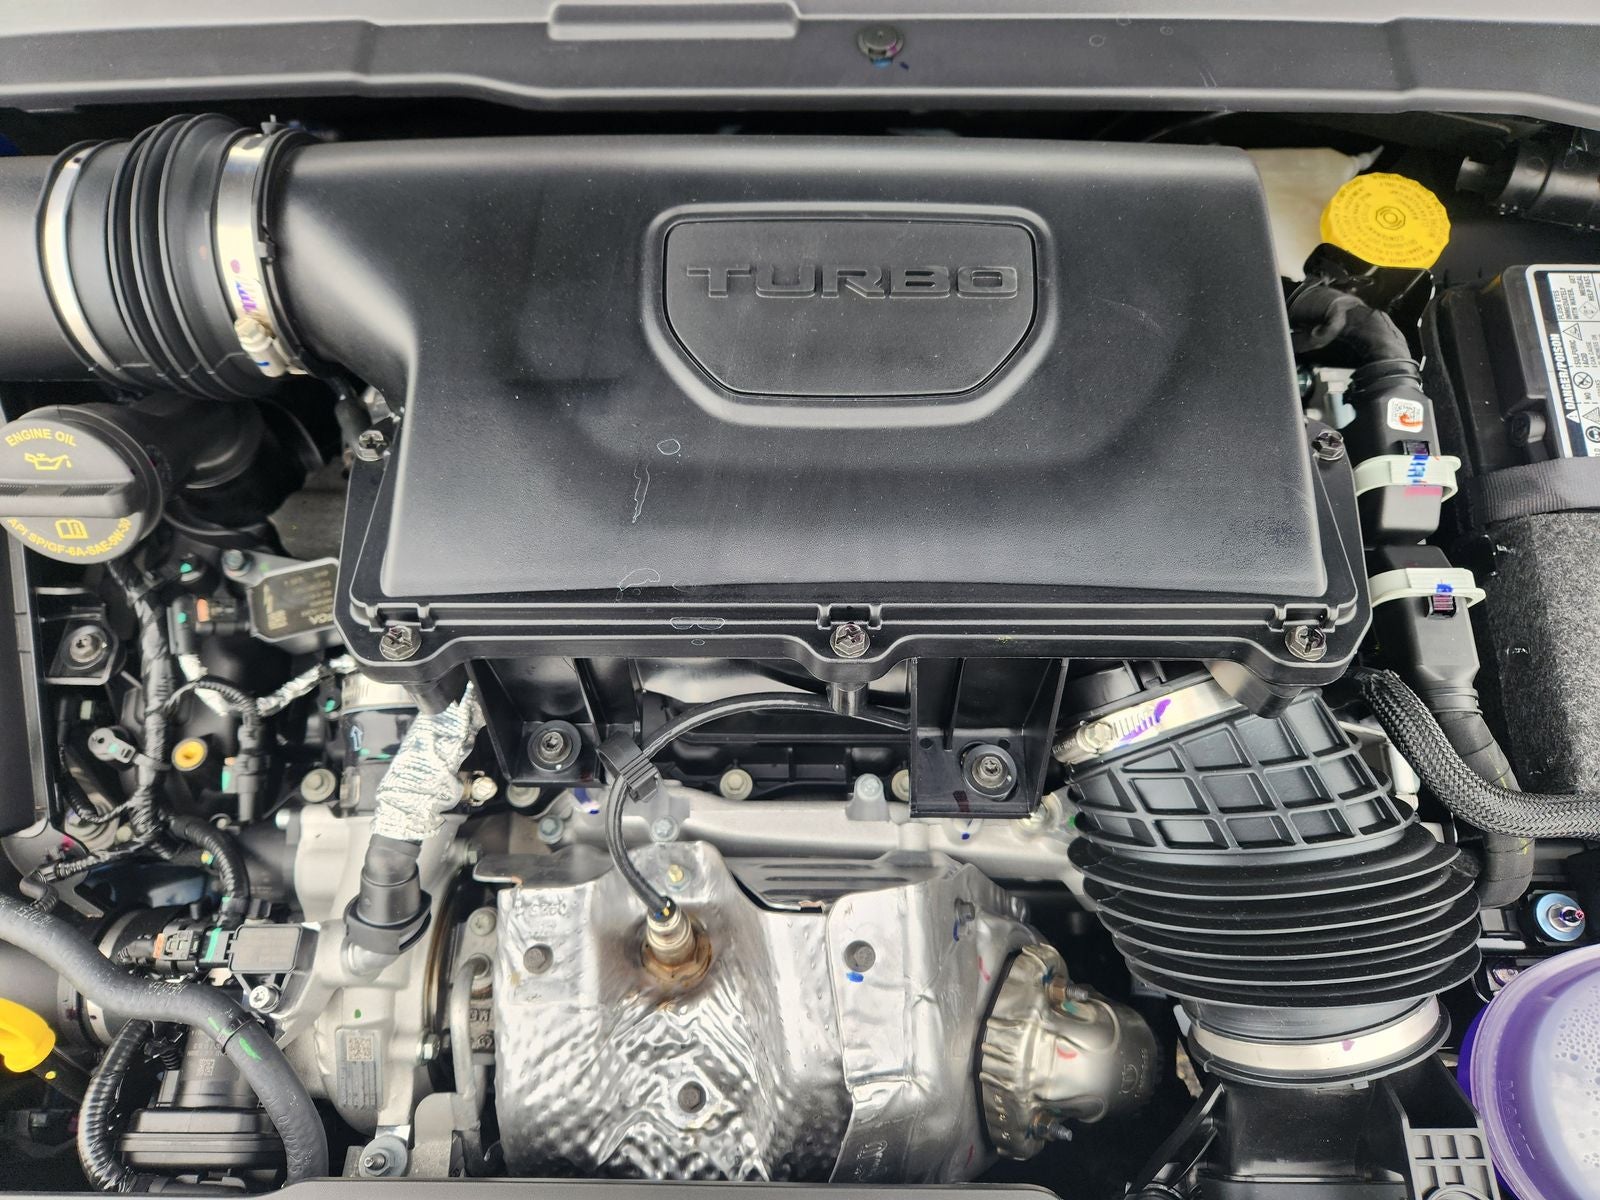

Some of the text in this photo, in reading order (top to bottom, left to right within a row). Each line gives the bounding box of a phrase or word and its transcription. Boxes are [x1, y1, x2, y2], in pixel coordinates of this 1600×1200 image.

[686, 265, 1018, 298] TURBO
[1553, 289, 1561, 302] EYES
[1550, 334, 1576, 410] DANGER/POISON
[5, 428, 77, 447] ENGINE OIL
[7, 518, 29, 536] API
